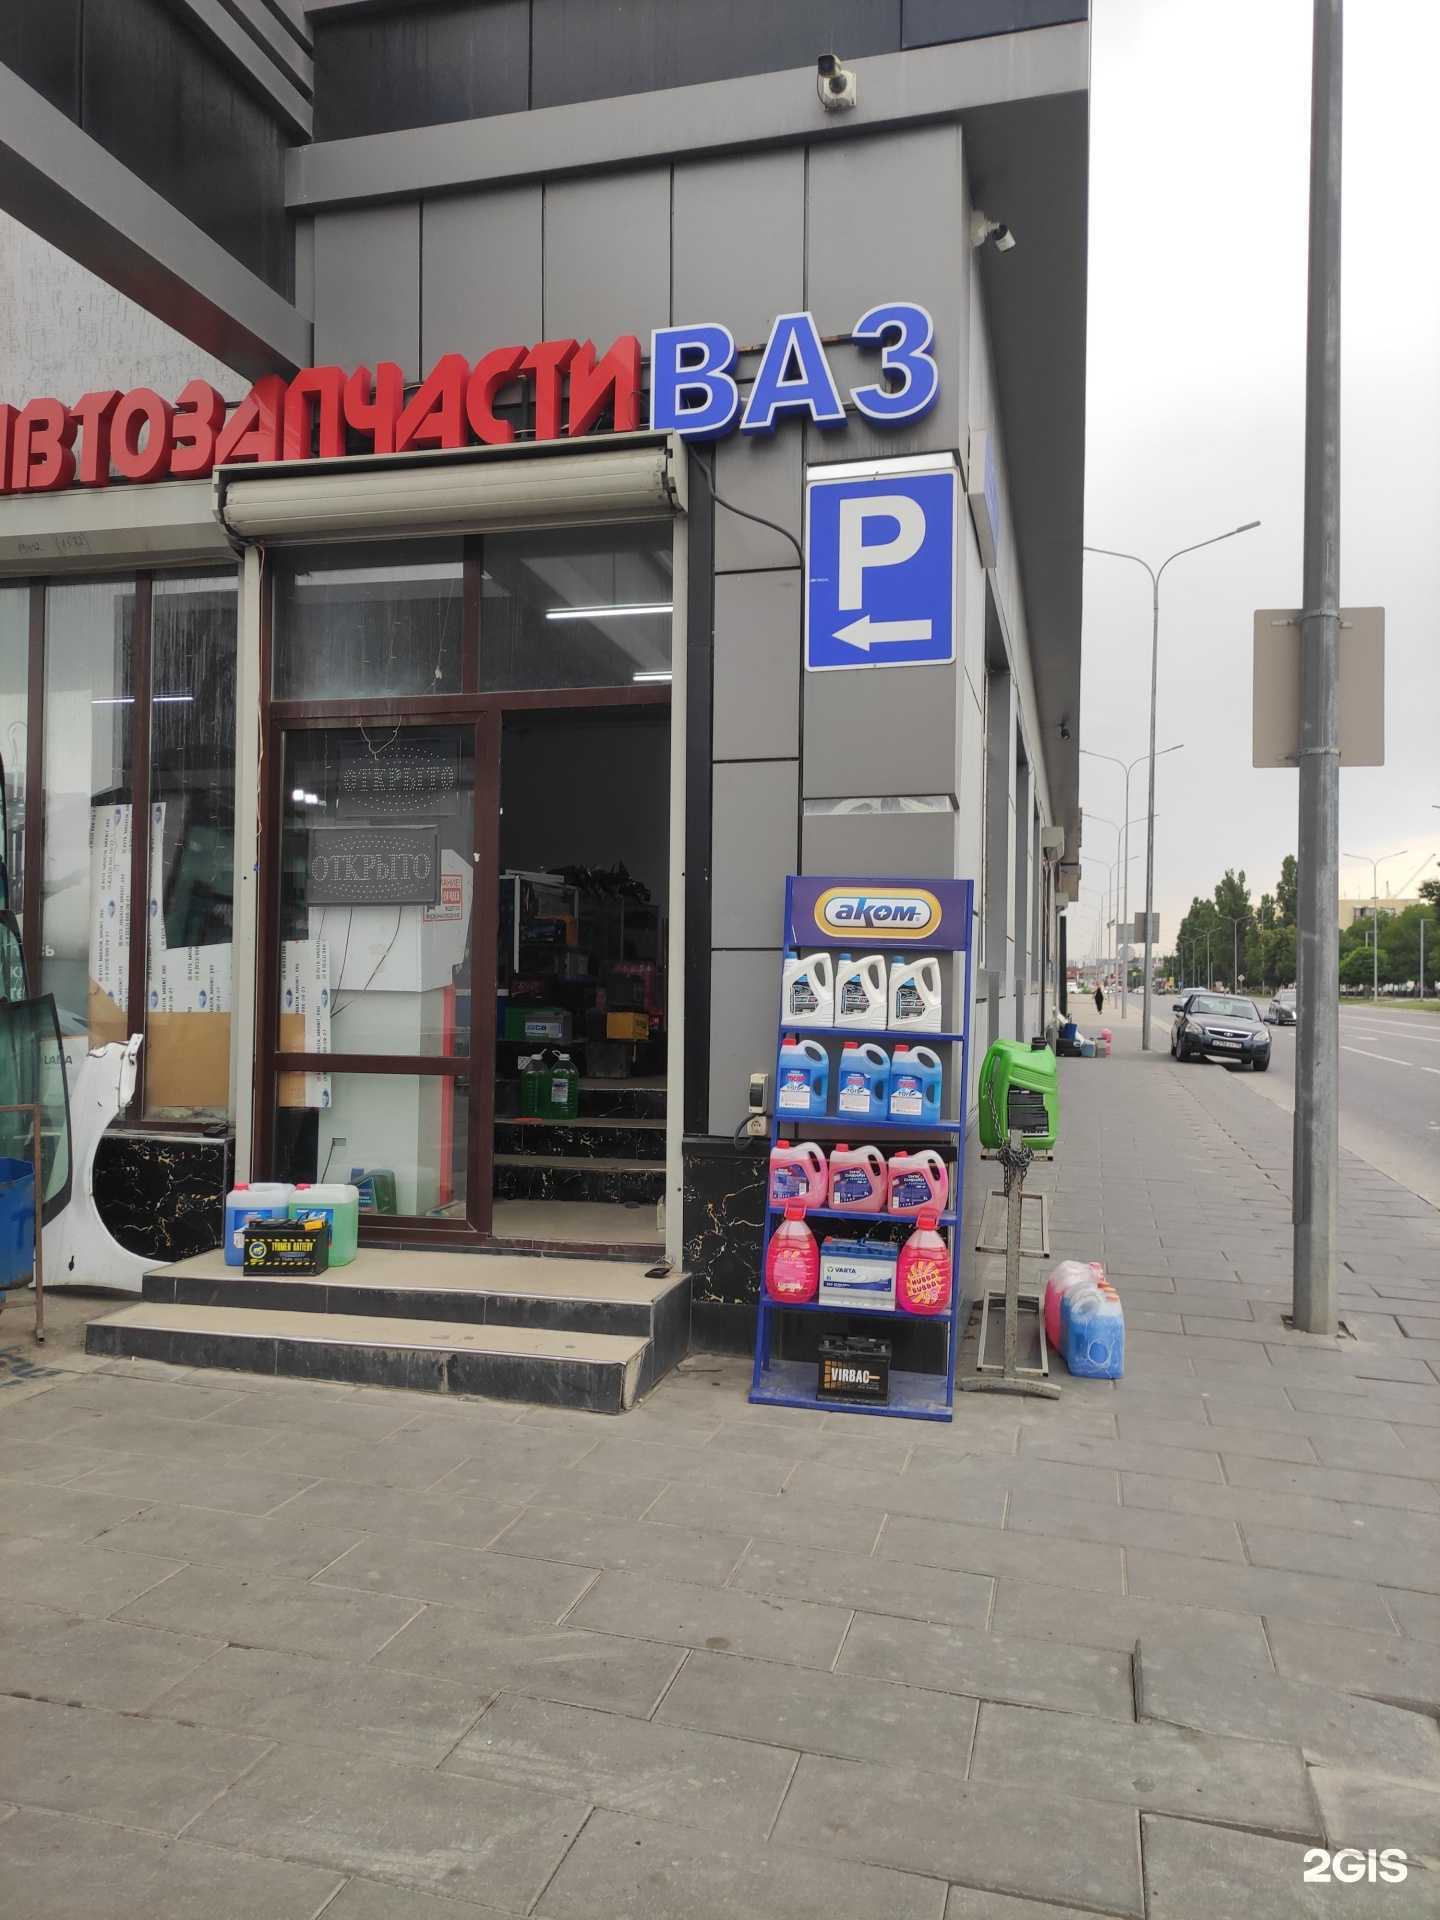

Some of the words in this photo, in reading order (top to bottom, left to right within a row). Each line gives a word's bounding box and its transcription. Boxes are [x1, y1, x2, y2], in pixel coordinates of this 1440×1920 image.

[650, 302, 940, 440] ВАЗ
[838, 495, 926, 611] P
[343, 766, 456, 792] ОТКРЫТО
[311, 853, 432, 881] ОТКРЫТО
[44, 1055, 73, 1065] LAA
